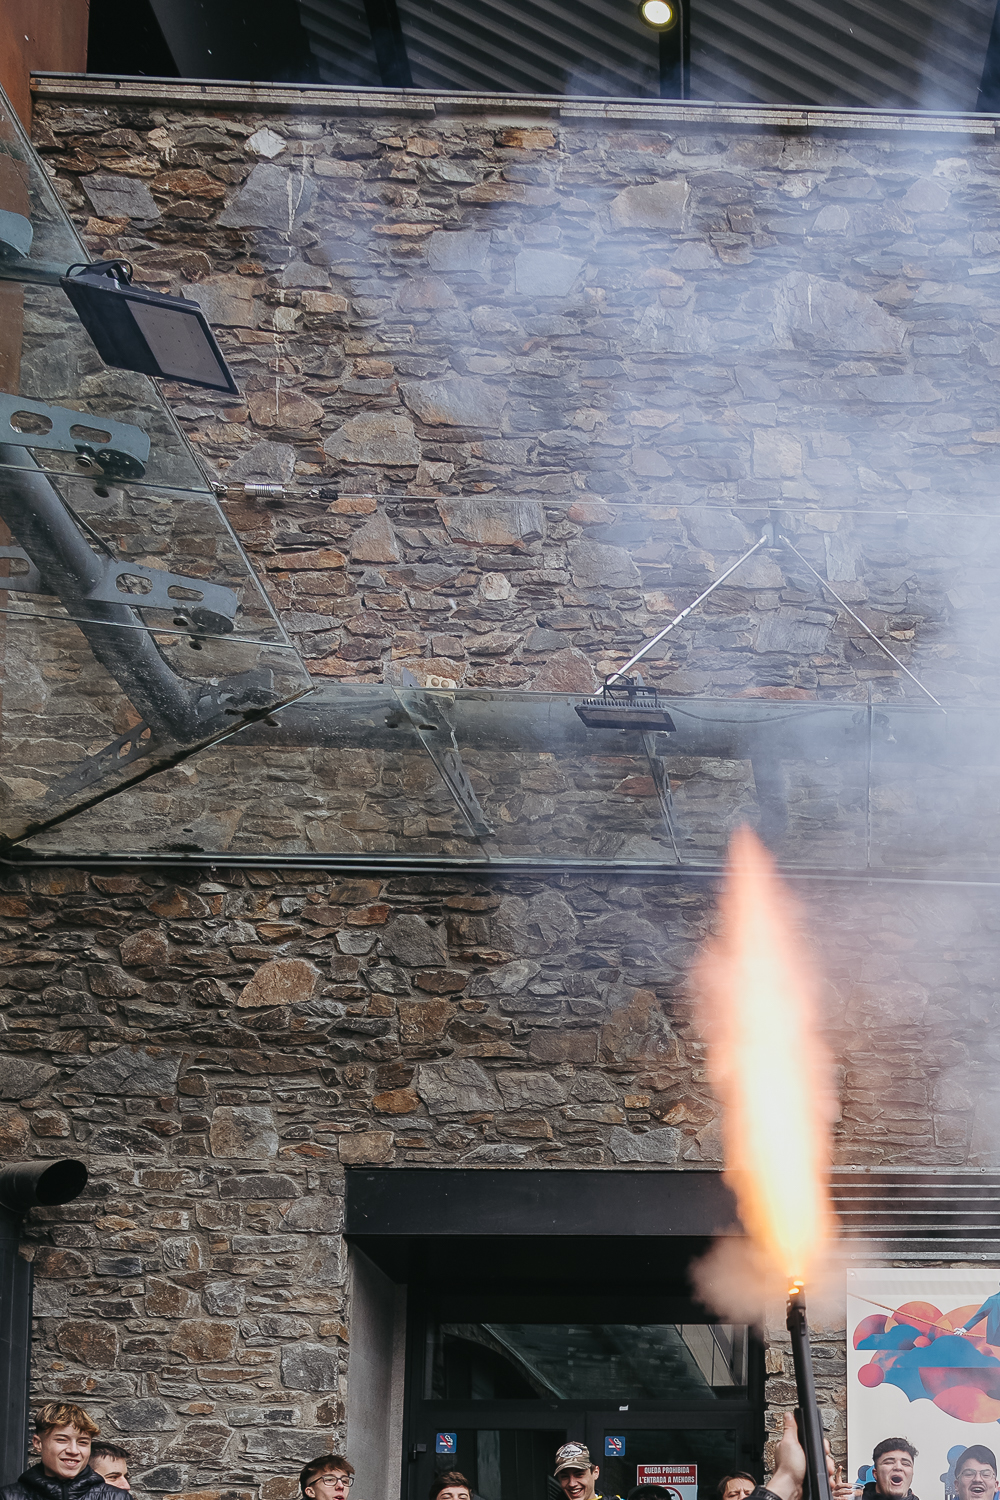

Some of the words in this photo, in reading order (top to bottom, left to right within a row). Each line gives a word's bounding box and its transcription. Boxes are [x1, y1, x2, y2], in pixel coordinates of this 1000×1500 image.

[644, 1466, 662, 1475] QUEDA
[662, 1466, 690, 1474] PROHIBIDA
[639, 1476, 667, 1484] L'ENTRADA
